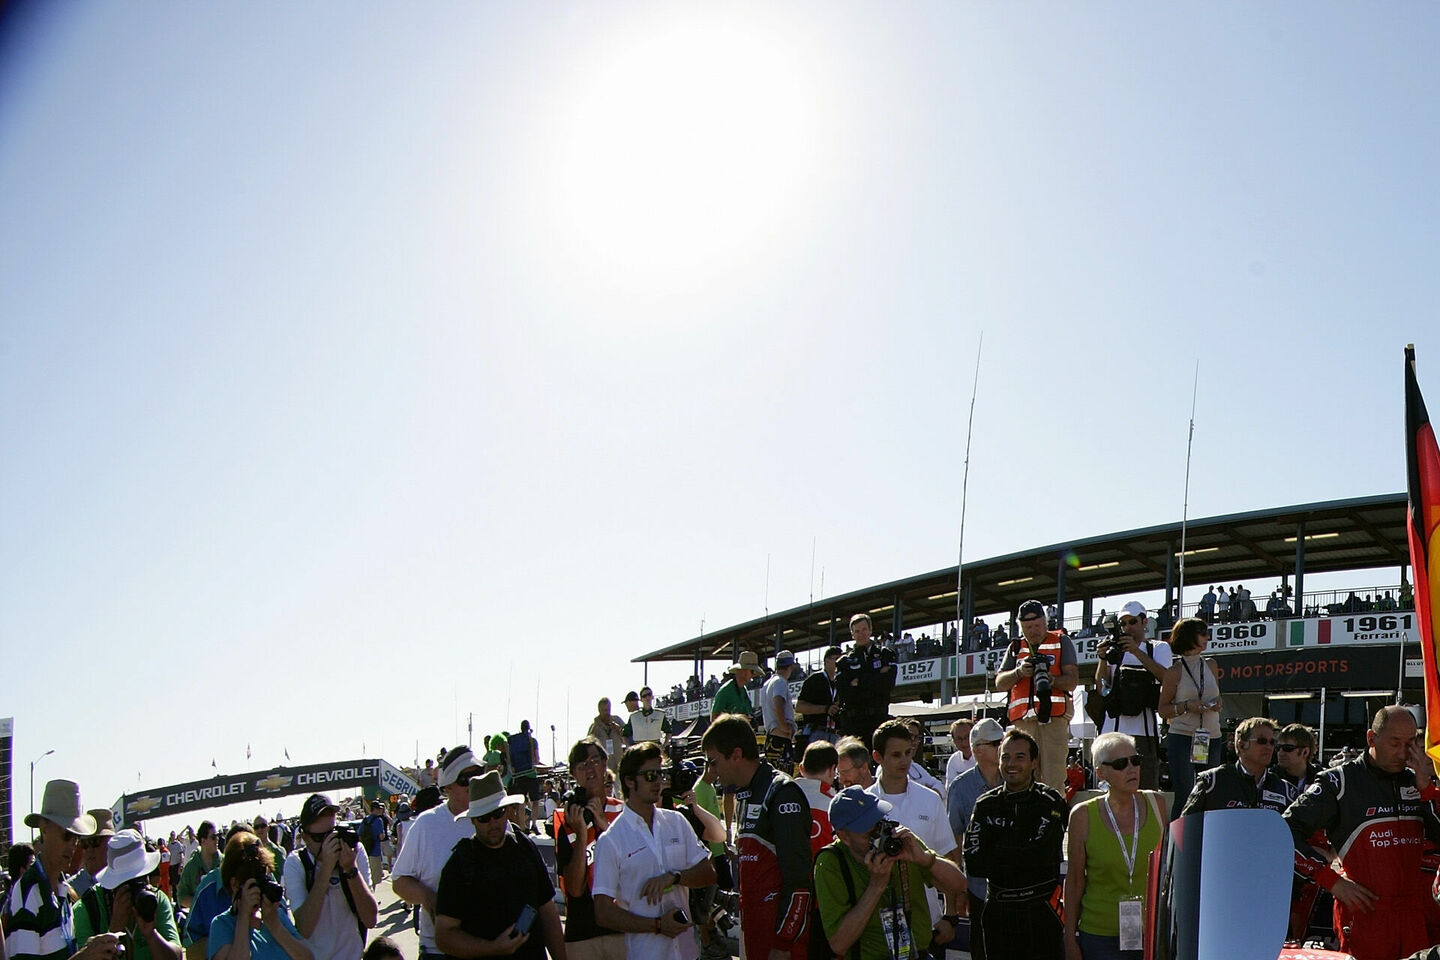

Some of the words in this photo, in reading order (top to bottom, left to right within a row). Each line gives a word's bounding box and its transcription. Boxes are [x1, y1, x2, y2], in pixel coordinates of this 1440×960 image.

[1343, 614, 1412, 633] 1961
[1354, 630, 1401, 641] Ferrari
[1210, 639, 1258, 649] Porsche
[900, 660, 935, 676] 1957
[1231, 658, 1349, 678] MOTORSPORTS
[902, 671, 933, 682] Maserati
[690, 700, 709, 712] 1953
[298, 765, 380, 786] CHEVROLET
[166, 781, 247, 806] CHEVROLET
[1369, 829, 1394, 840] Audi
[1369, 839, 1391, 848] Top
